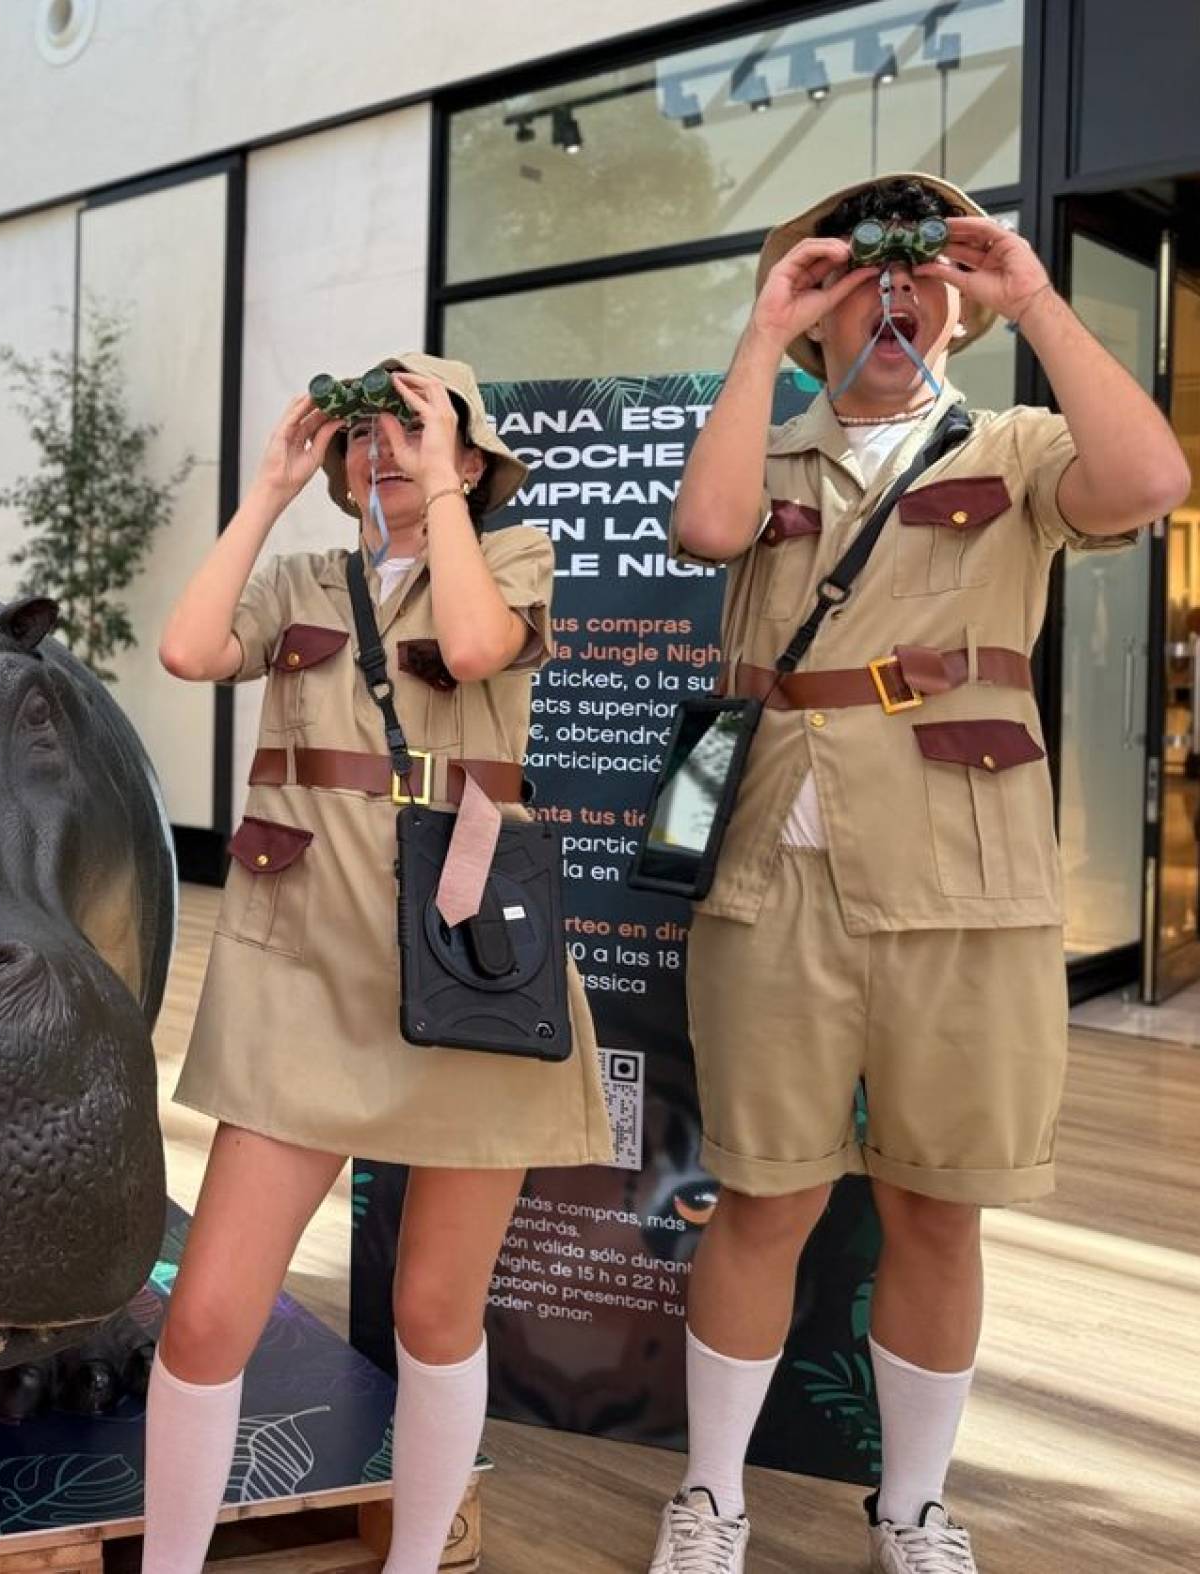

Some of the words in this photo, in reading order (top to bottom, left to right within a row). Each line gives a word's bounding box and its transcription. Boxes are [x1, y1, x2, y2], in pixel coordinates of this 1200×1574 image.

[511, 443, 685, 470] COCHE
[604, 517, 667, 541] LA
[585, 617, 693, 637] compras
[579, 642, 659, 667] Jungle
[549, 668, 629, 691] ticket,
[634, 674, 651, 690] o
[657, 671, 680, 691] la
[580, 807, 616, 826] tus
[561, 836, 639, 856] partic
[563, 859, 584, 878] la
[591, 865, 620, 882] en
[565, 916, 610, 936] rteo
[618, 922, 648, 939] en
[593, 947, 608, 963] a
[616, 945, 651, 968] las
[657, 949, 681, 970] 18
[515, 1195, 552, 1213] más
[557, 1201, 642, 1227] compras,
[647, 1214, 687, 1232] más
[533, 1239, 585, 1260] válida
[589, 1246, 627, 1266] sólo
[550, 1260, 573, 1278] de
[577, 1264, 595, 1282] 15
[599, 1267, 611, 1285] h
[614, 1273, 628, 1288] a
[631, 1272, 656, 1292] 22
[562, 1285, 659, 1313] presentar
[662, 1301, 686, 1318] tu
